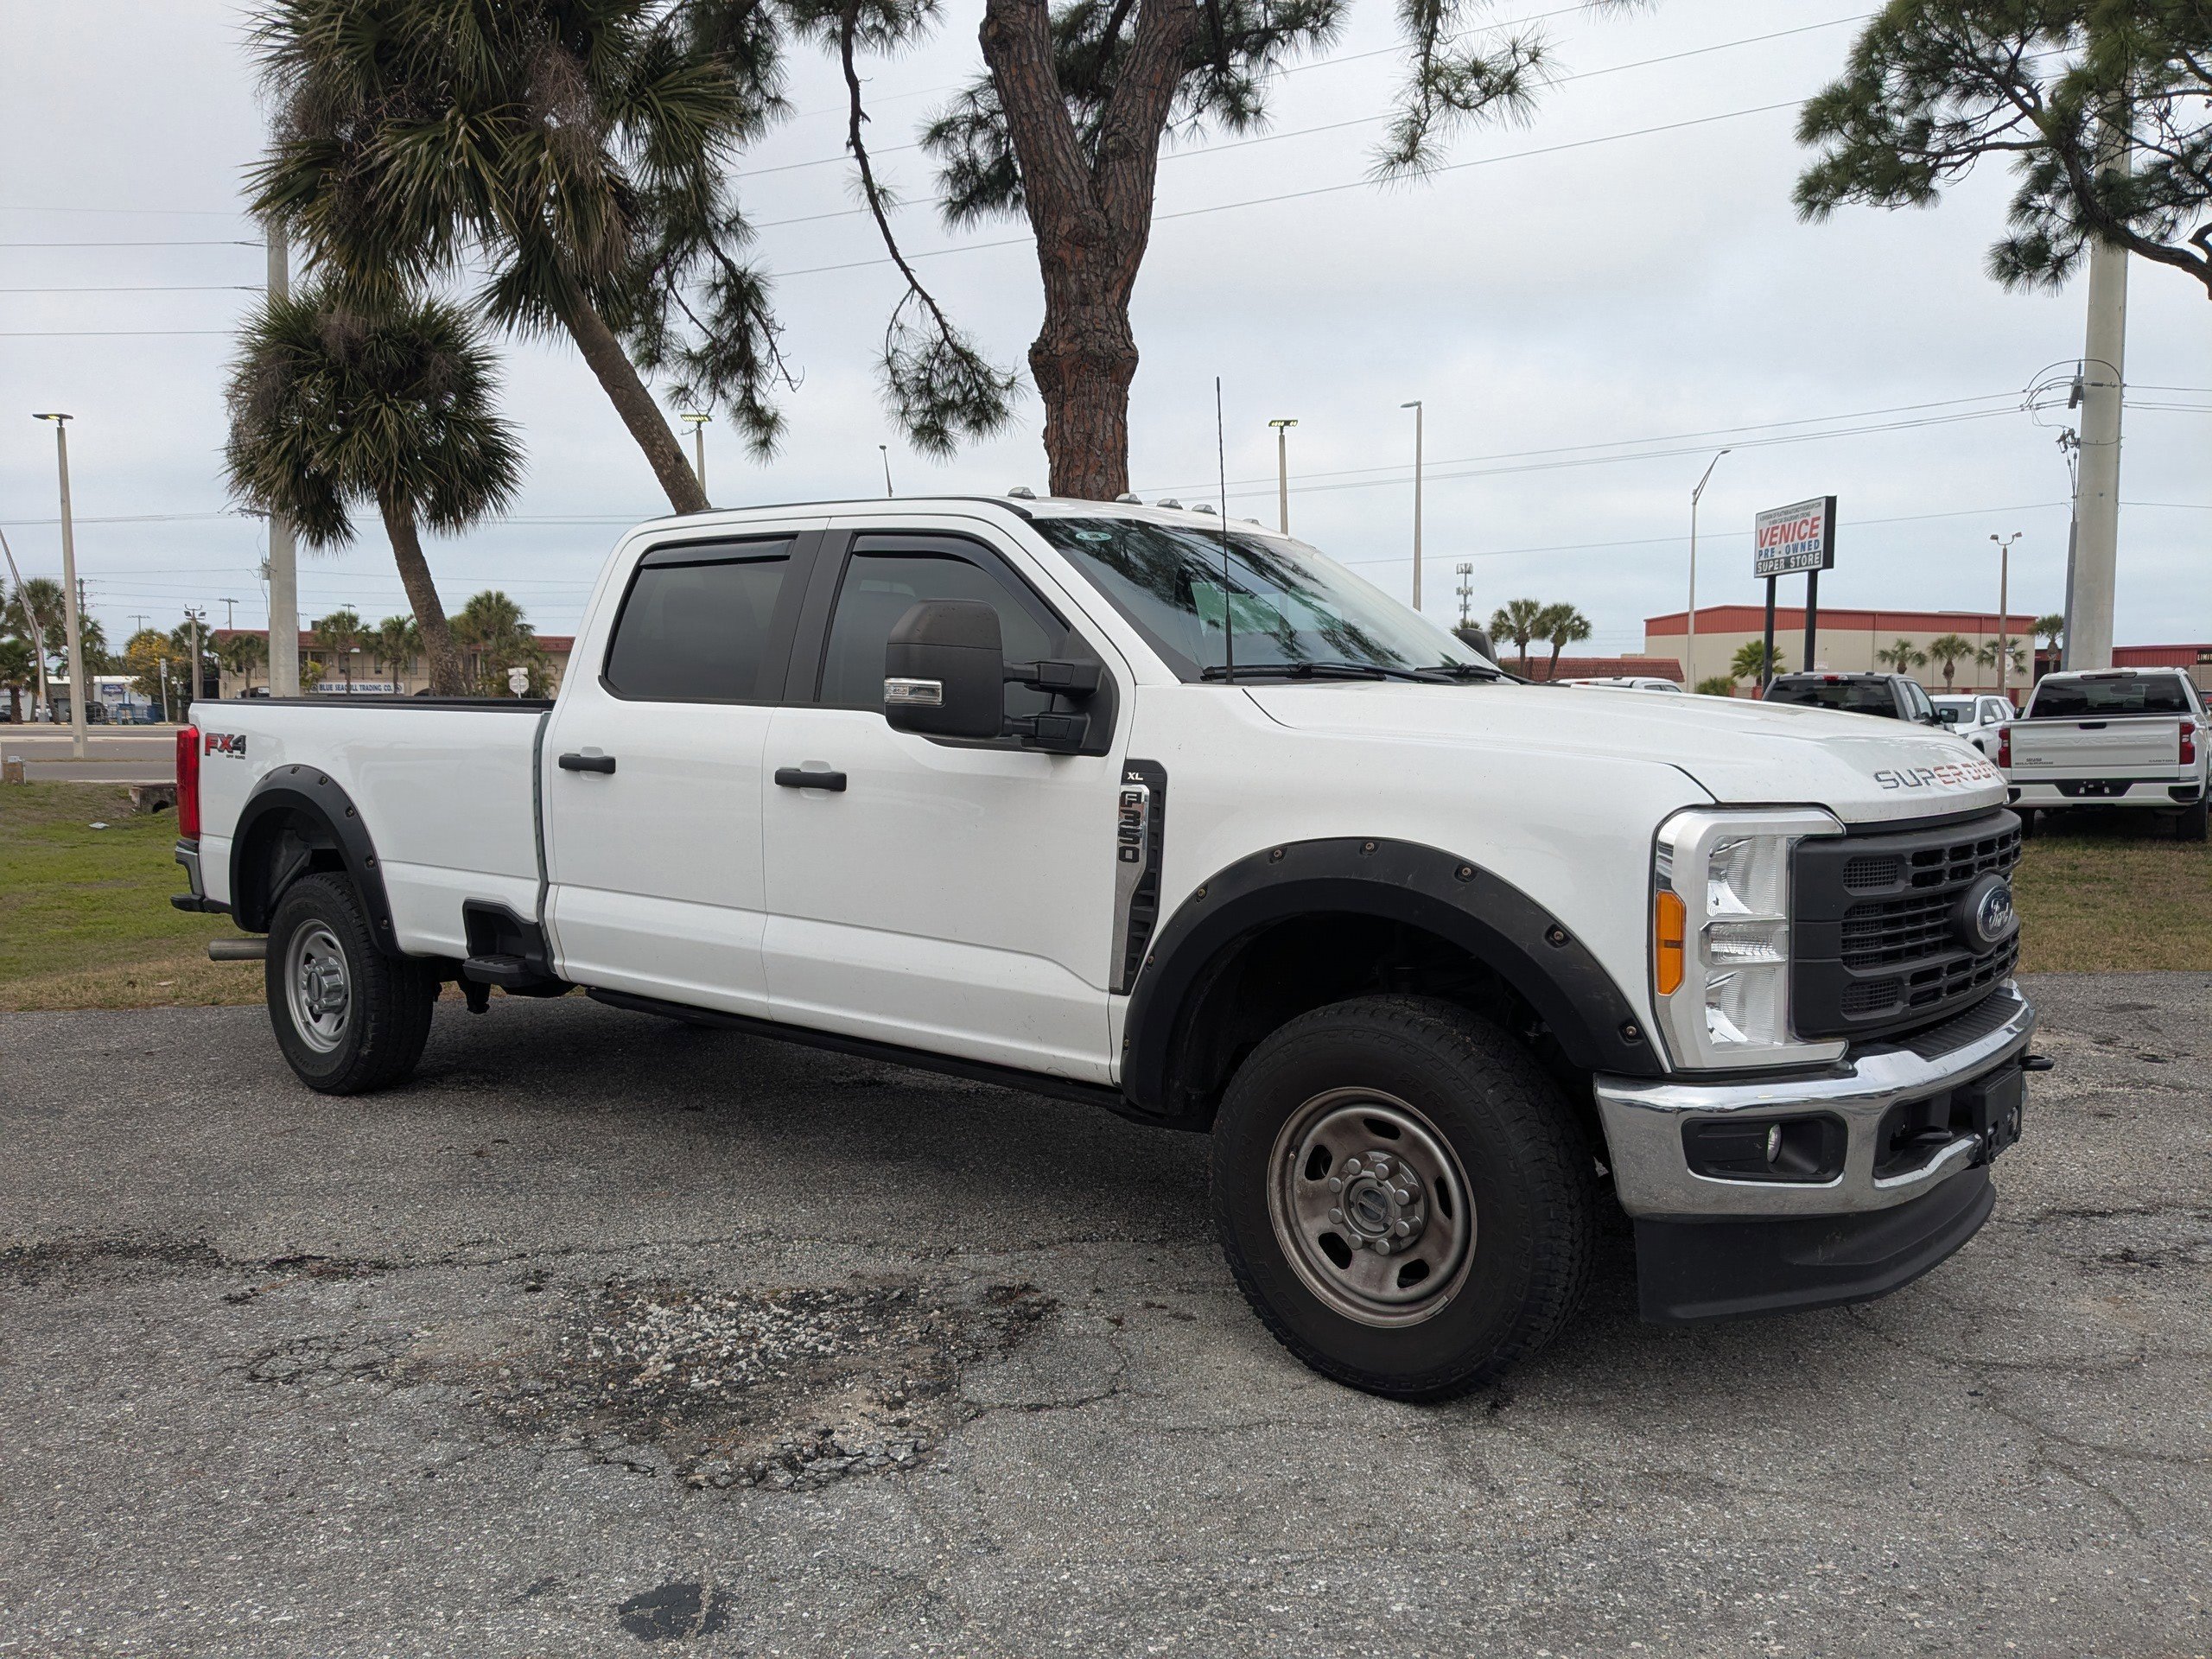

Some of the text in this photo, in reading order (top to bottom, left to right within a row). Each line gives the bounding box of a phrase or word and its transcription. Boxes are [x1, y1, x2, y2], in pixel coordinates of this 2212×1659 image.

[1758, 516, 1821, 549] VENICE
[1758, 547, 1776, 560] PRE
[1785, 539, 1820, 555] OWNED
[1757, 552, 1821, 573] SUPER STORE
[205, 733, 246, 756] FX4
[2020, 734, 2170, 747] CHEVROLET
[1126, 772, 1144, 781] XL
[1873, 764, 1967, 790] SUPER
[1989, 897, 2009, 931] Ford
